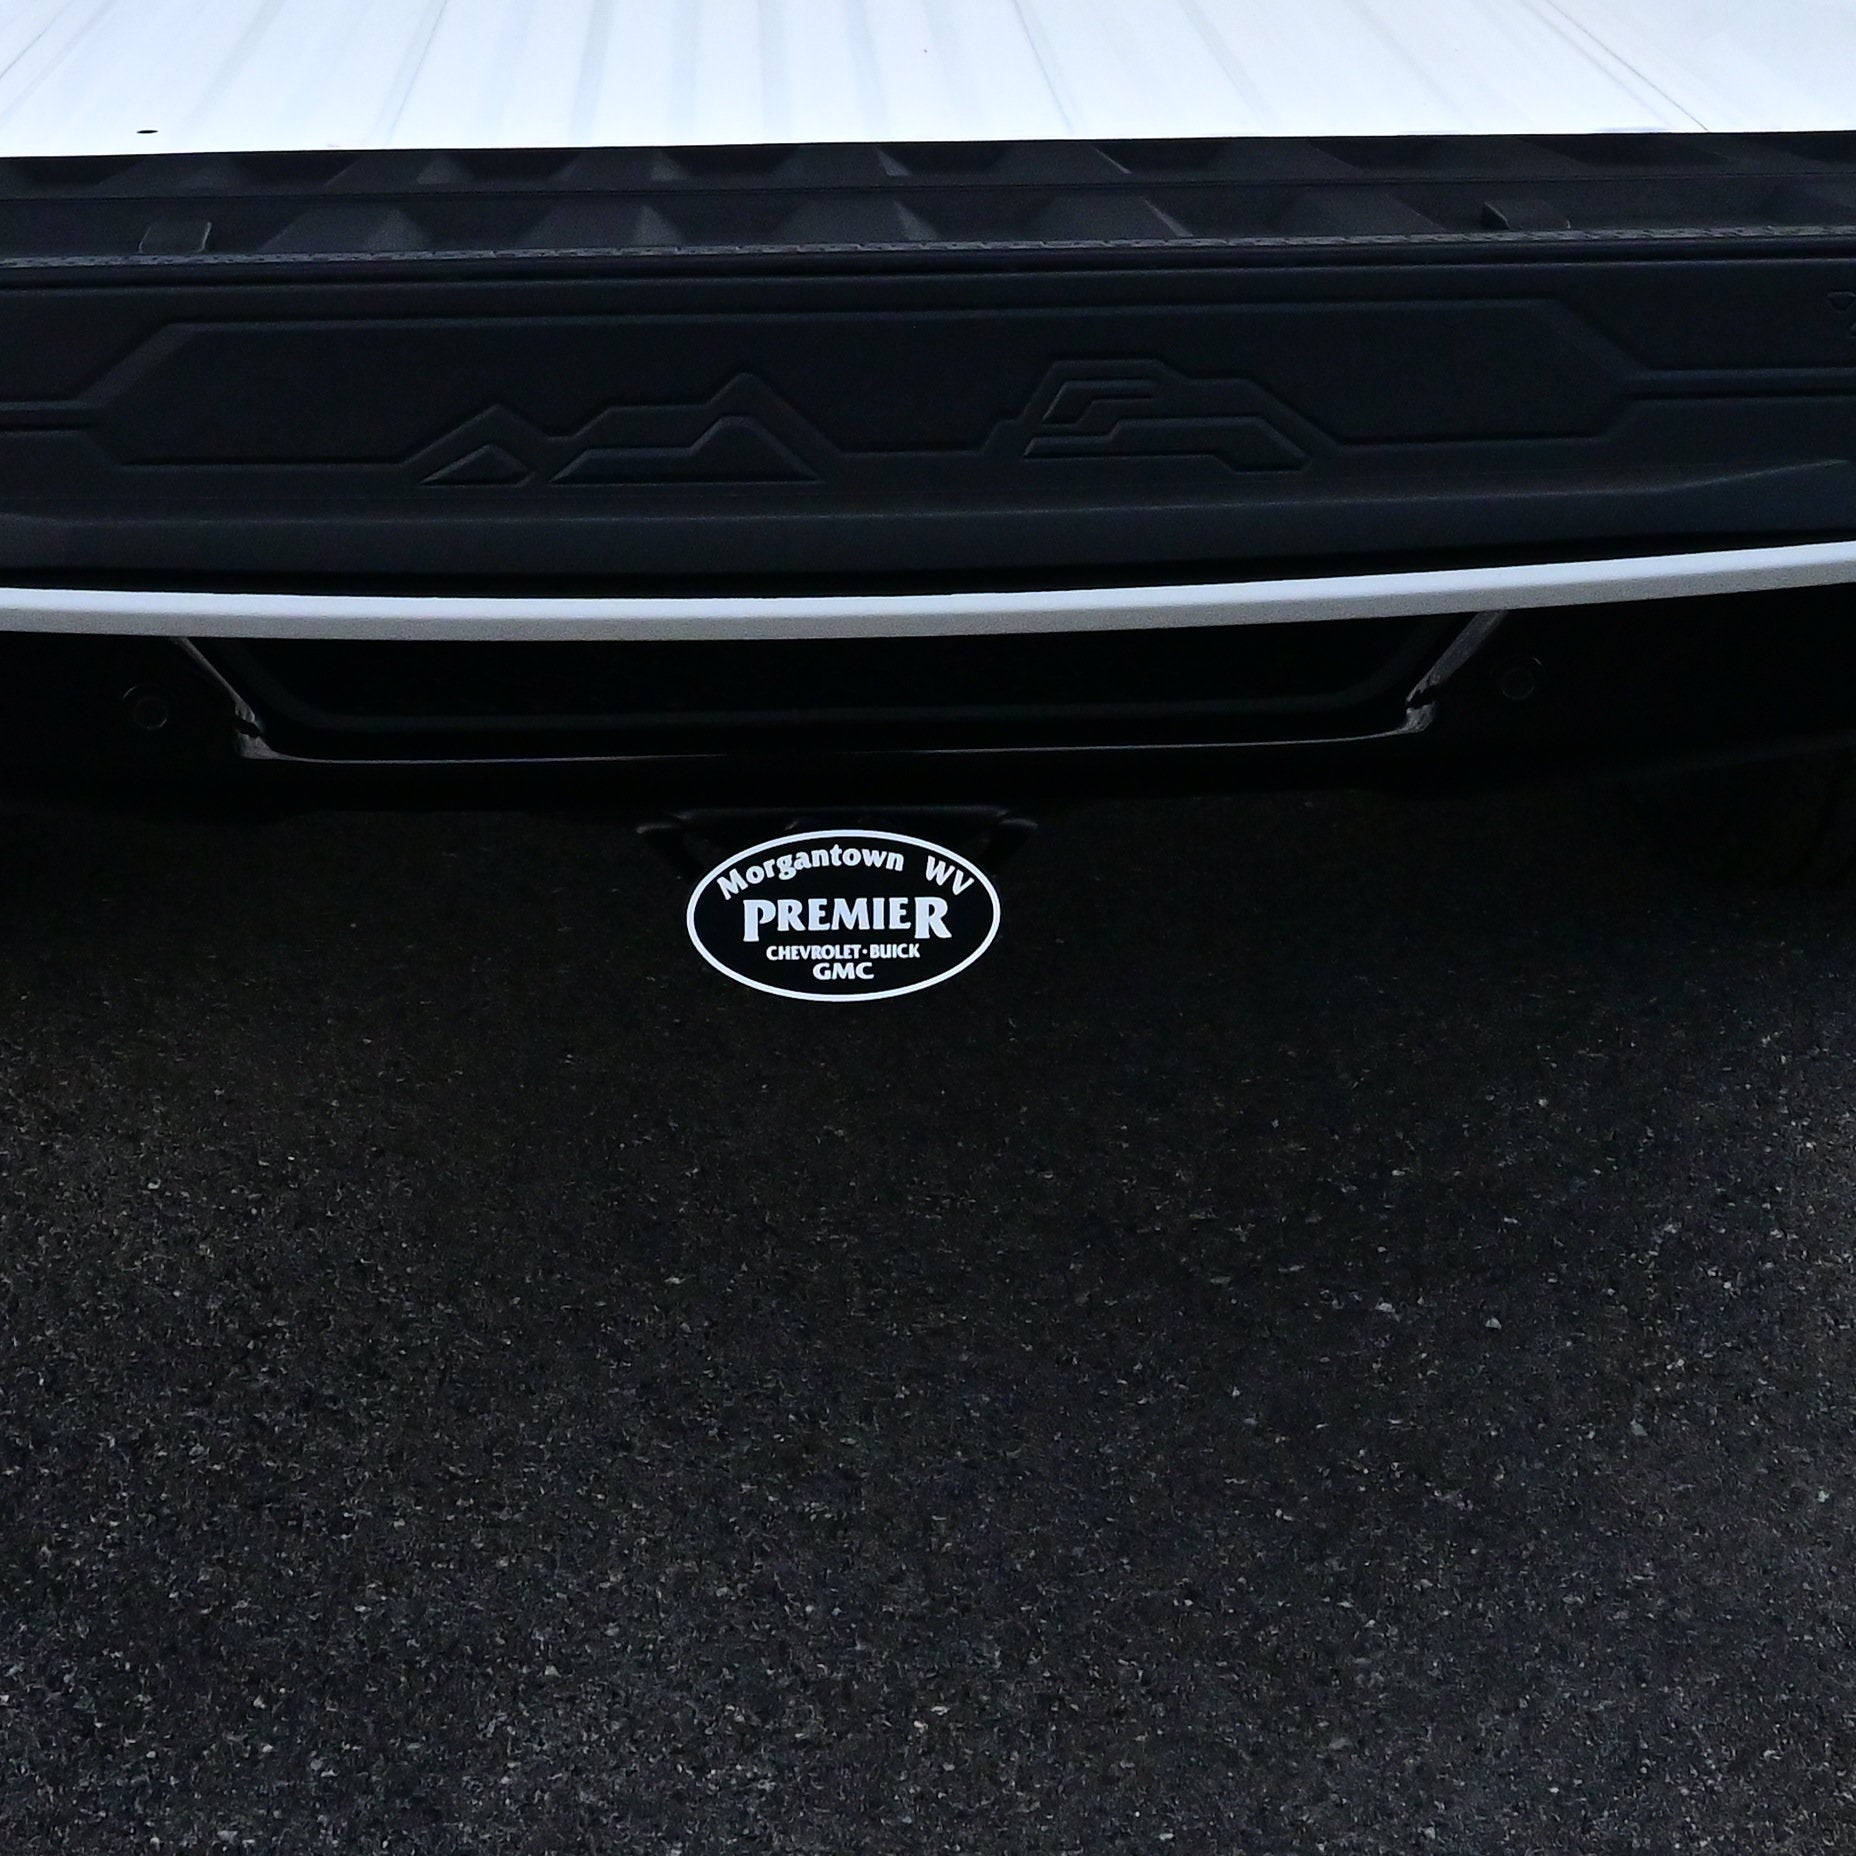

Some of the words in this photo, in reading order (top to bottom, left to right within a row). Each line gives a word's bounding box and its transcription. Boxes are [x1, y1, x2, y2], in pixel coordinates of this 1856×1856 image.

[716, 844, 904, 900] Morgantown
[923, 855, 975, 895] WV
[743, 896, 952, 942] PREMIER
[812, 962, 875, 980] GMC
